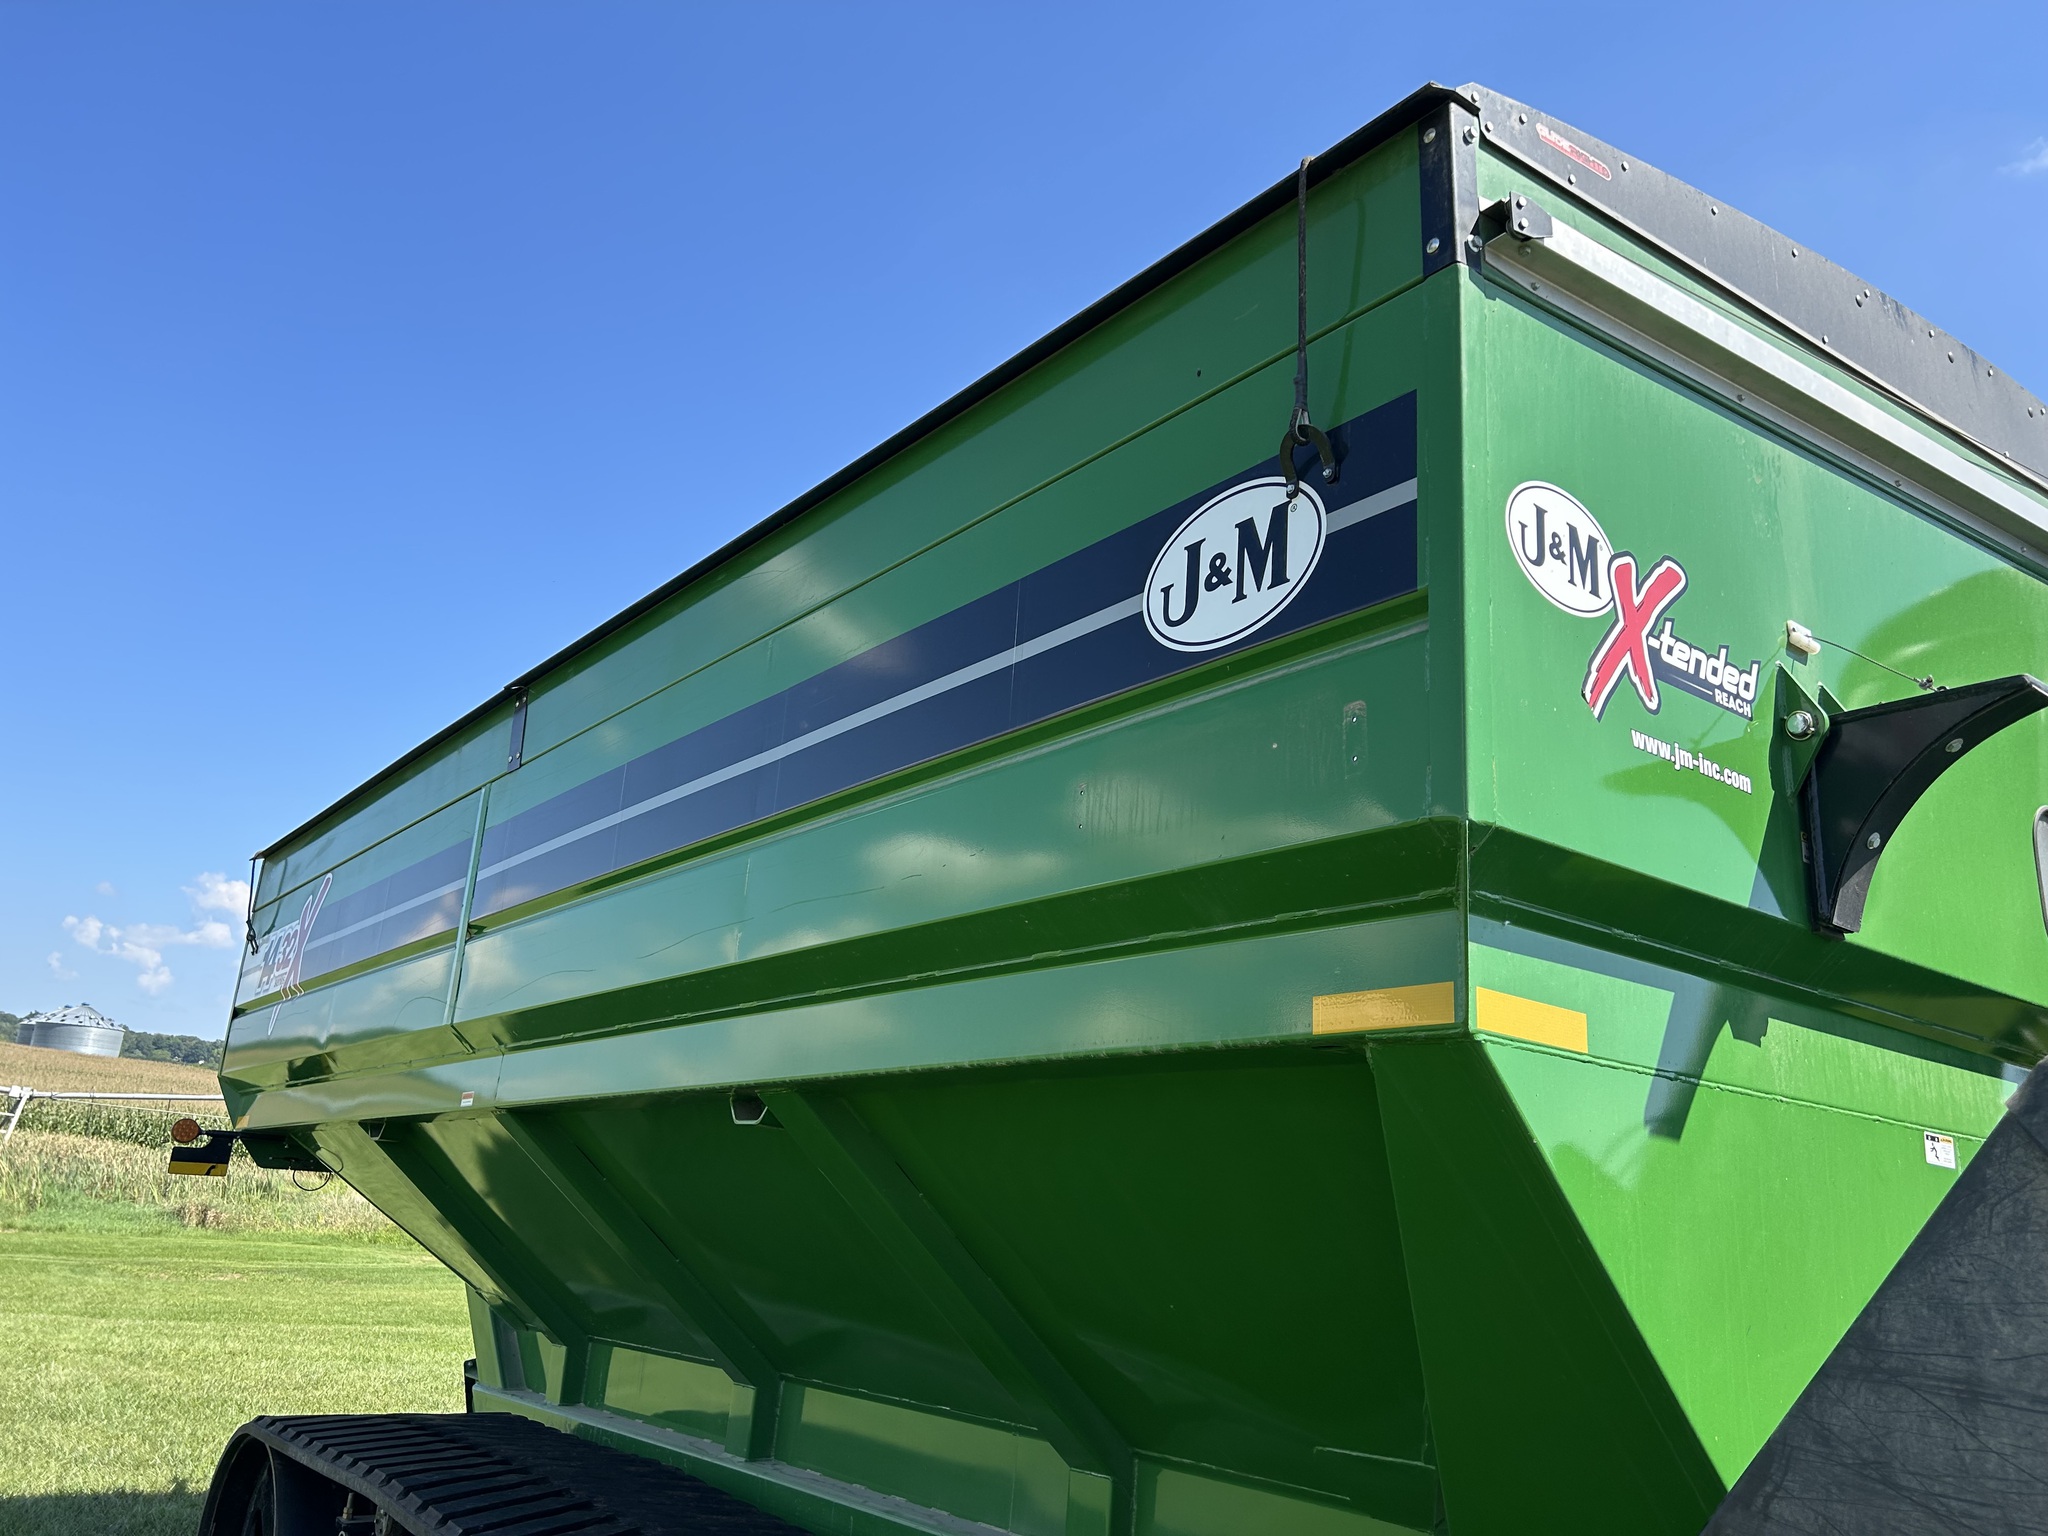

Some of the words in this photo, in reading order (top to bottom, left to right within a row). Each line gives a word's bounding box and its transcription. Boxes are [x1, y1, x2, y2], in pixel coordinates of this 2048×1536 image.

[1160, 499, 1291, 628] J&M
[1518, 503, 1602, 600] J&M
[1714, 688, 1753, 719] REACH
[1630, 728, 1753, 796] www.jm-inc.com
